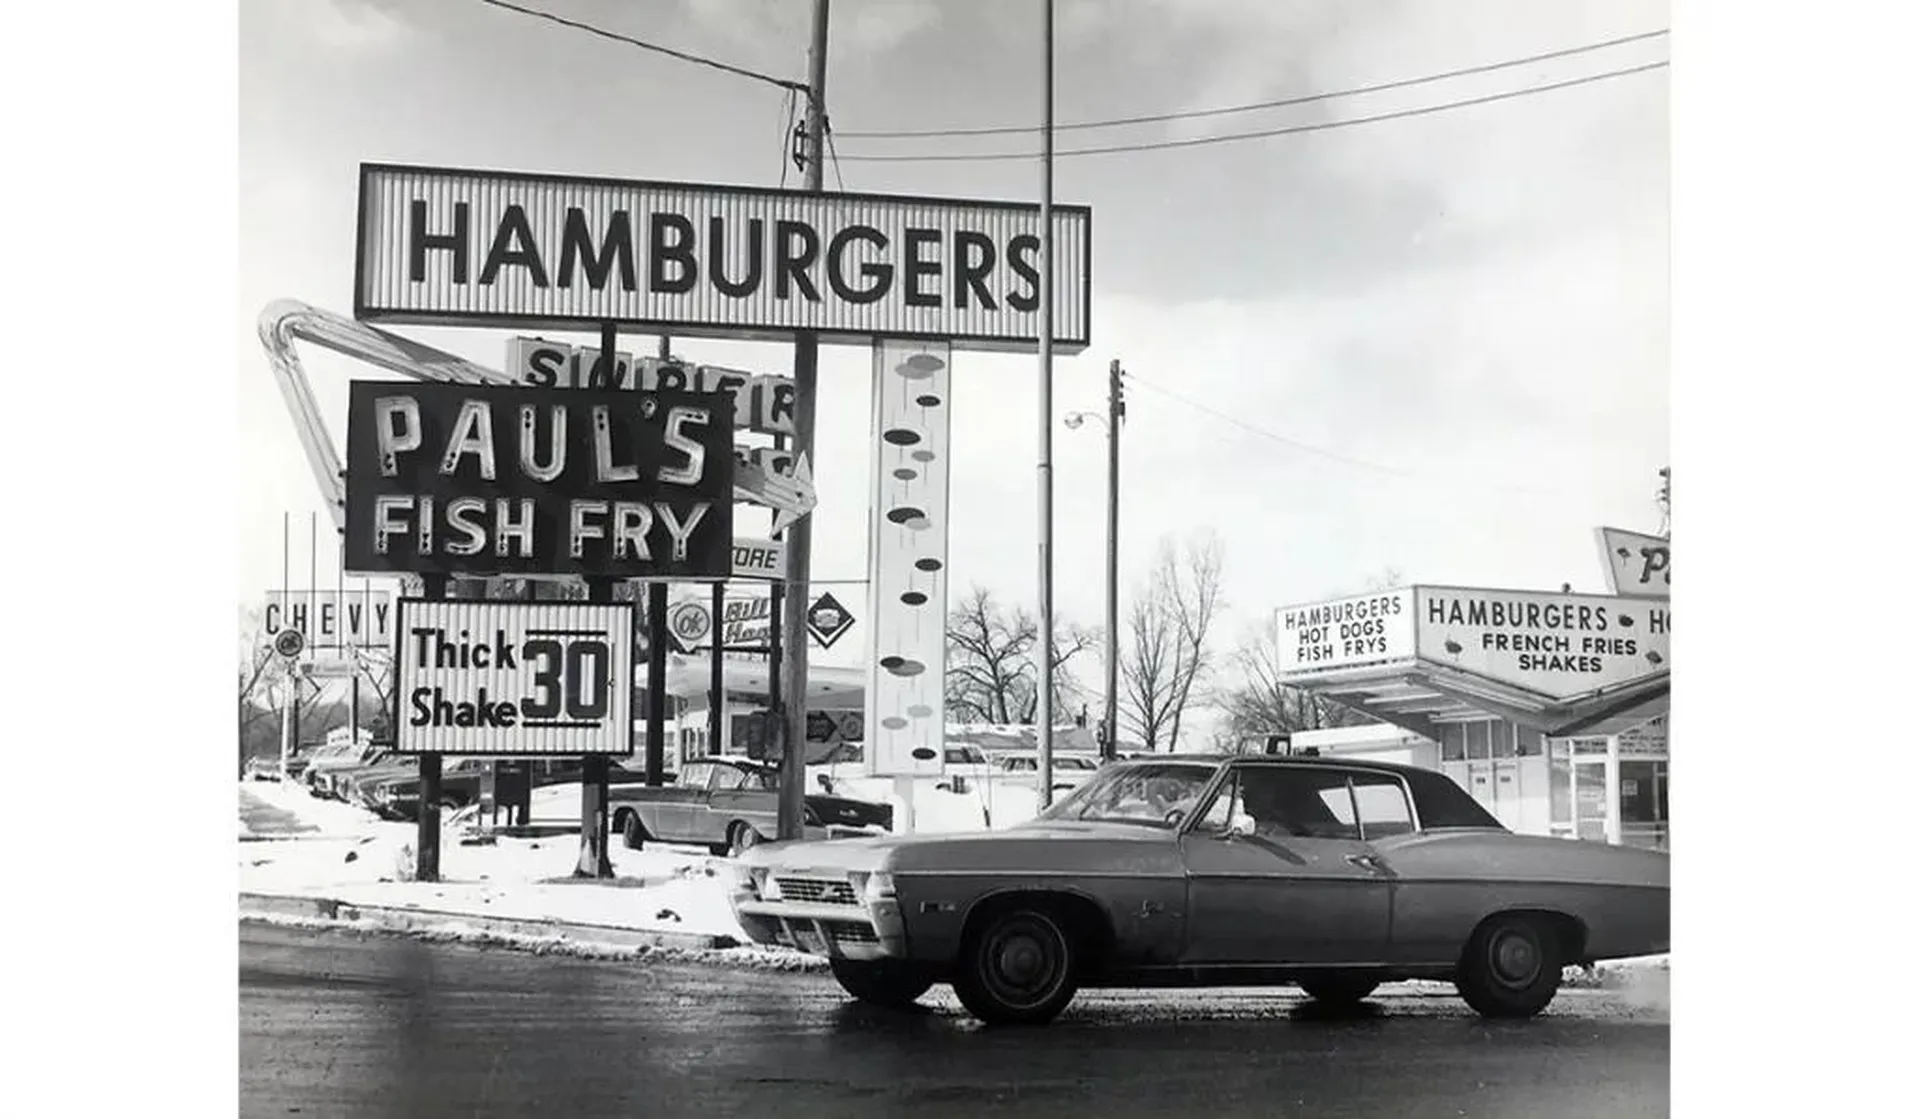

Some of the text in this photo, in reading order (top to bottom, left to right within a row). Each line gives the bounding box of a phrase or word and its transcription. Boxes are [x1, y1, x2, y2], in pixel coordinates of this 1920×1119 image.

[409, 199, 1041, 313] HAMBURGERS
[374, 396, 711, 487] PAUL'S
[374, 494, 712, 562] FISH FRY
[732, 546, 778, 570] ORE
[1639, 545, 1671, 585] P
[266, 603, 389, 636] CHEVY
[680, 611, 705, 634] OK
[725, 597, 770, 620] Bill
[1285, 595, 1401, 631] HAMBURGERS
[1428, 598, 1671, 634] HAMBURGERS H
[411, 627, 517, 670] Thick
[1297, 636, 1387, 662] FISH FRYS
[1299, 618, 1385, 645] HOT DOGS
[1482, 632, 1638, 657] FRENCH FRIES
[520, 639, 610, 720] 30
[1519, 654, 1603, 673] SHAKES
[410, 686, 518, 729] Shake
